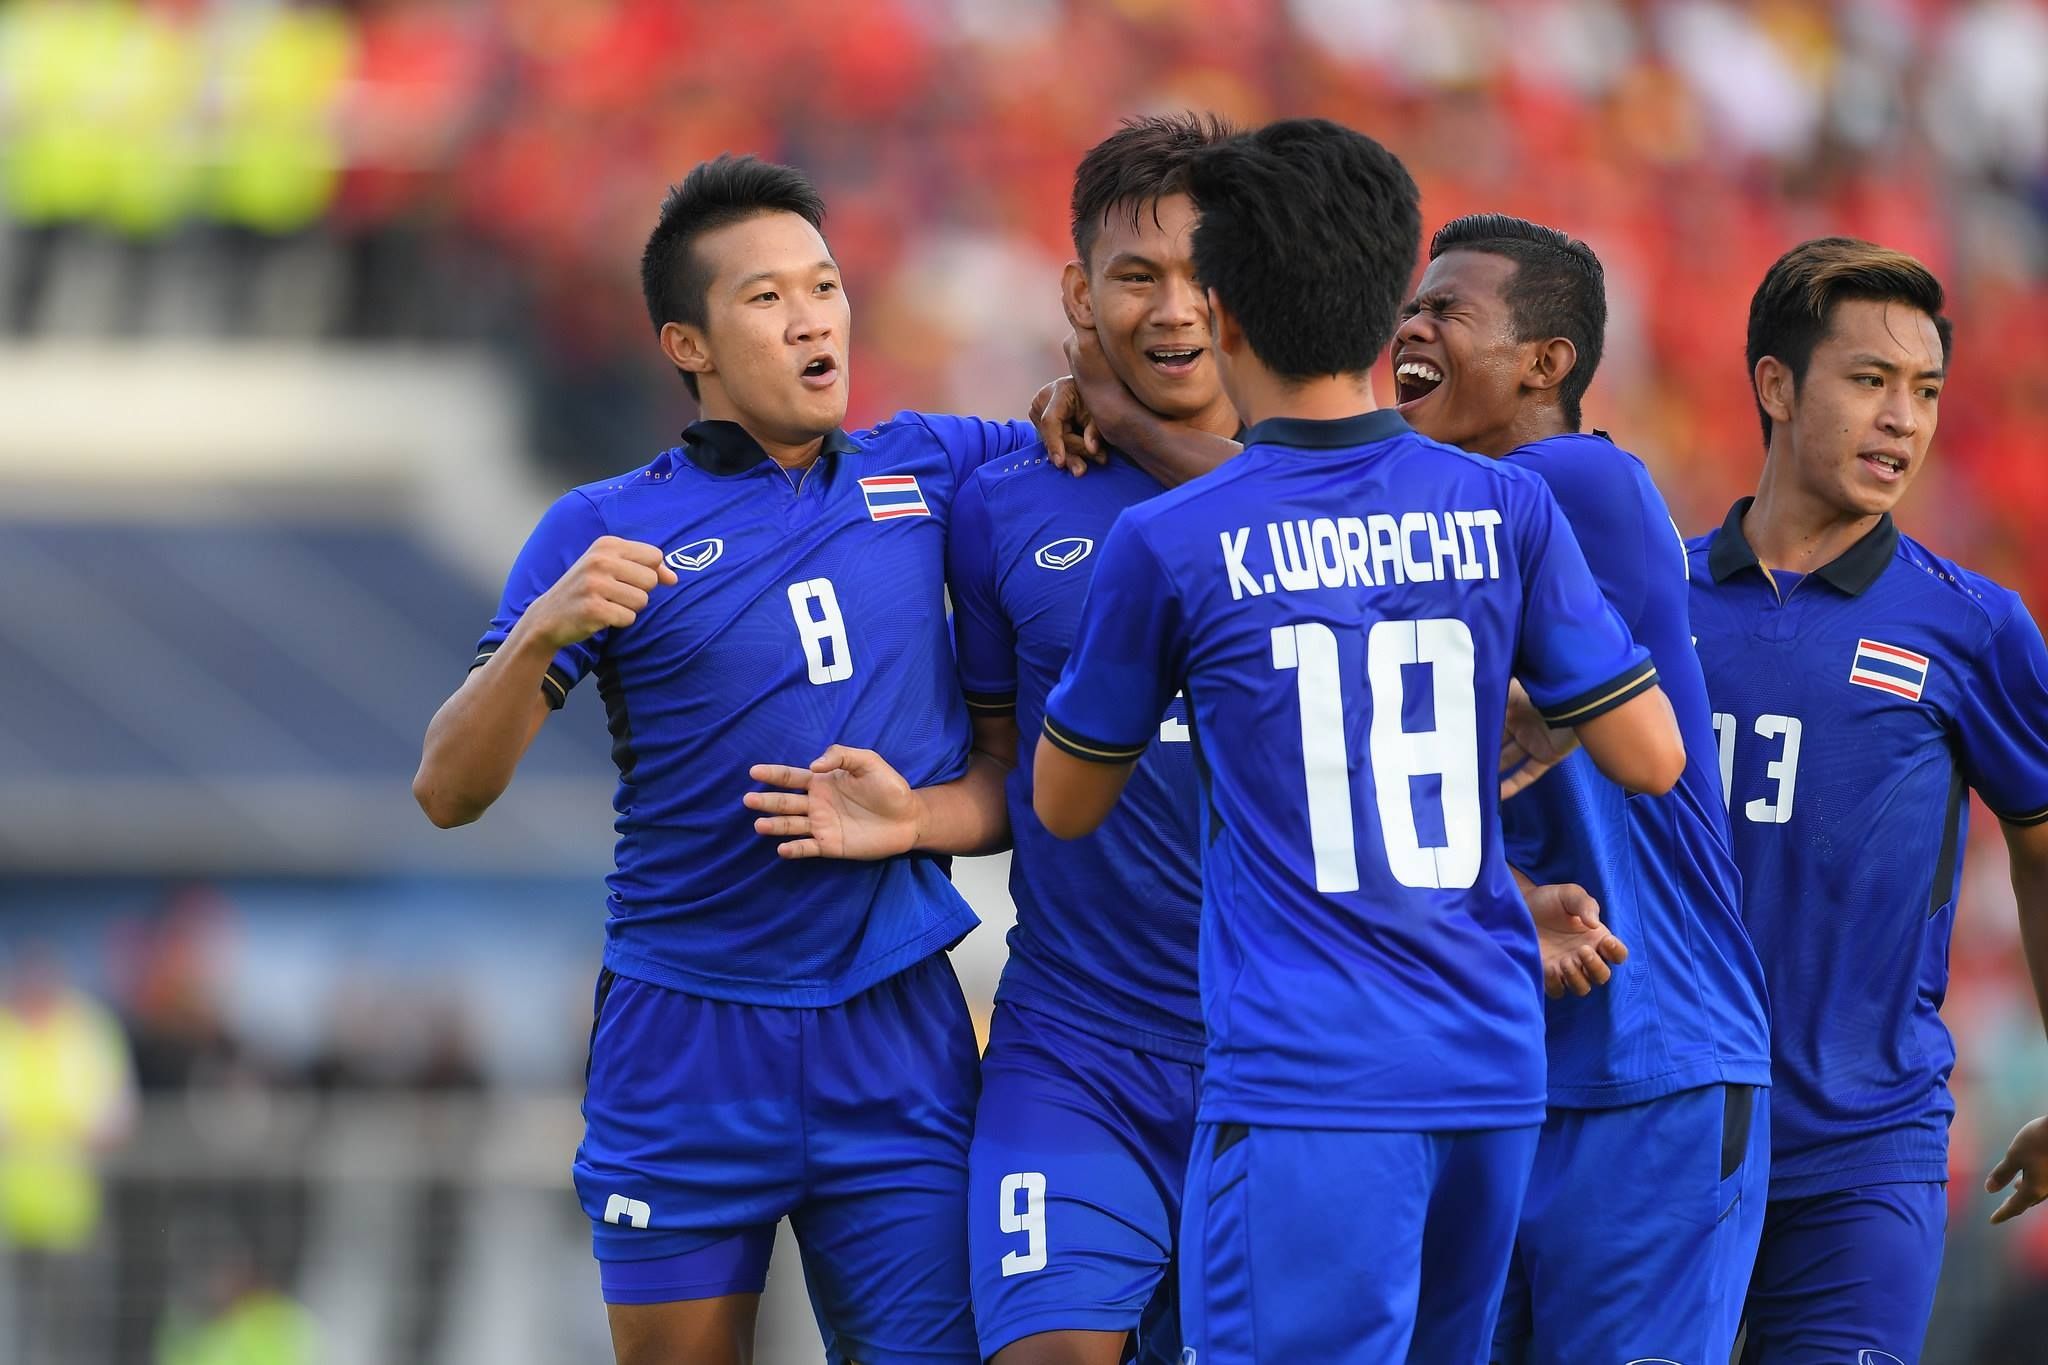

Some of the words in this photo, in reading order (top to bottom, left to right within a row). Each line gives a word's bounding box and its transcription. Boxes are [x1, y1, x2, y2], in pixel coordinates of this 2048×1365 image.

[1219, 509, 1503, 601] K.WORACHIT
[787, 577, 854, 685] 8
[1270, 618, 1482, 894] 18
[1712, 712, 1803, 824] 13
[999, 1172, 1048, 1277] 9
